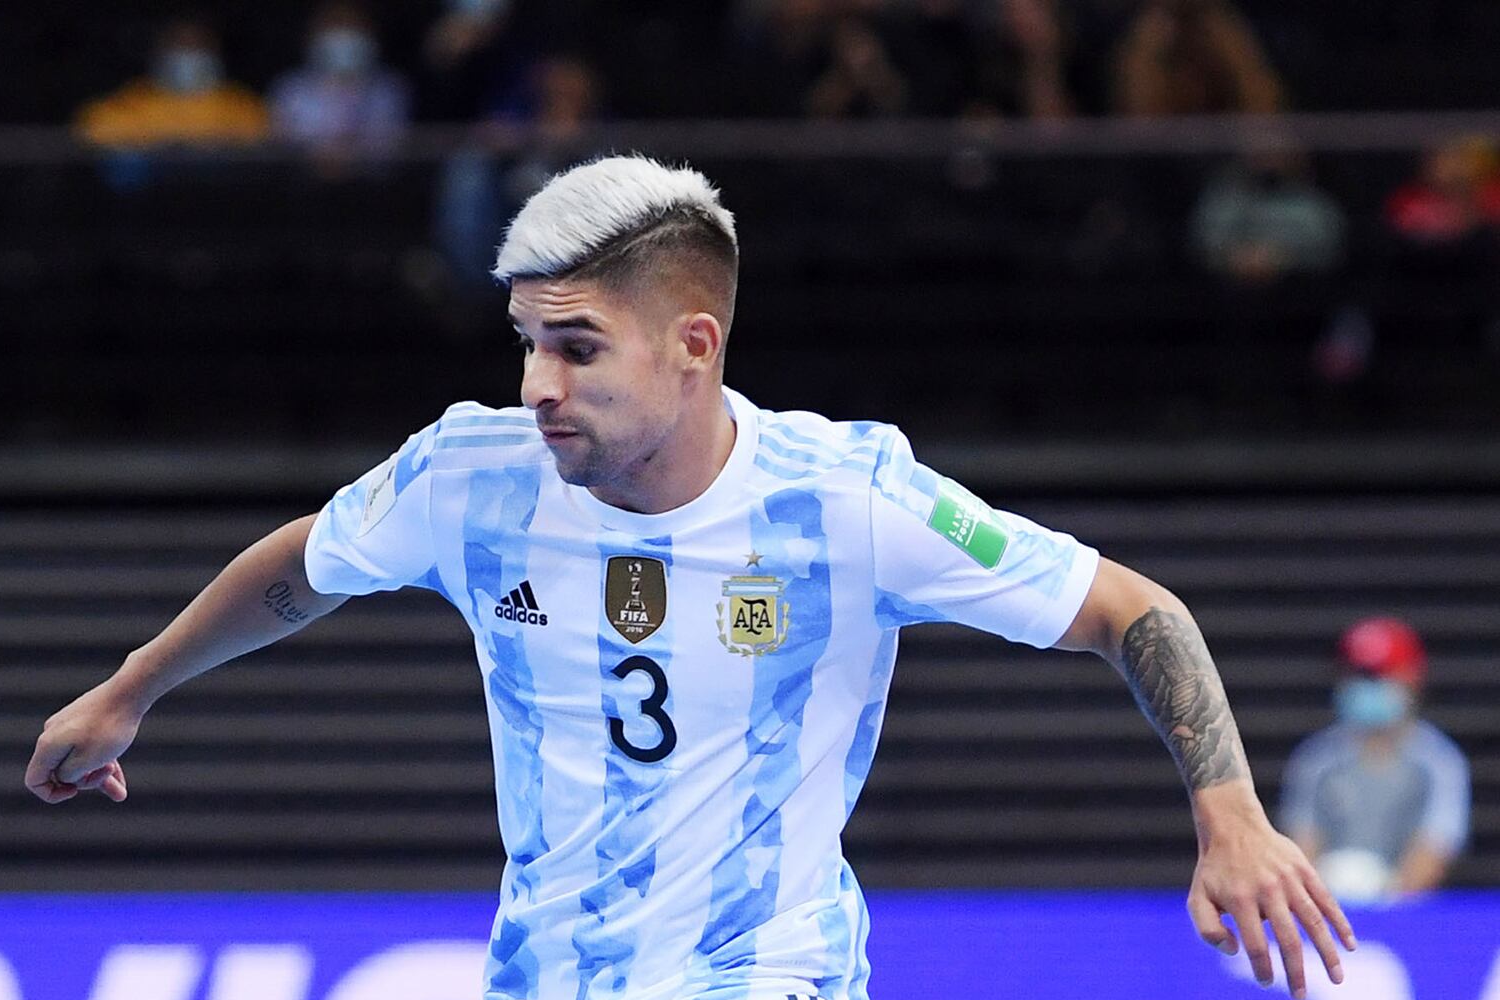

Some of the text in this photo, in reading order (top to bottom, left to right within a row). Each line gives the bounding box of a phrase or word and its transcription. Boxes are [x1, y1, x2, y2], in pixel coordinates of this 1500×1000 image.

[494, 604, 548, 626] adidas
[620, 609, 649, 622] FIFA
[733, 597, 773, 635] AFA
[609, 655, 677, 763] 3
